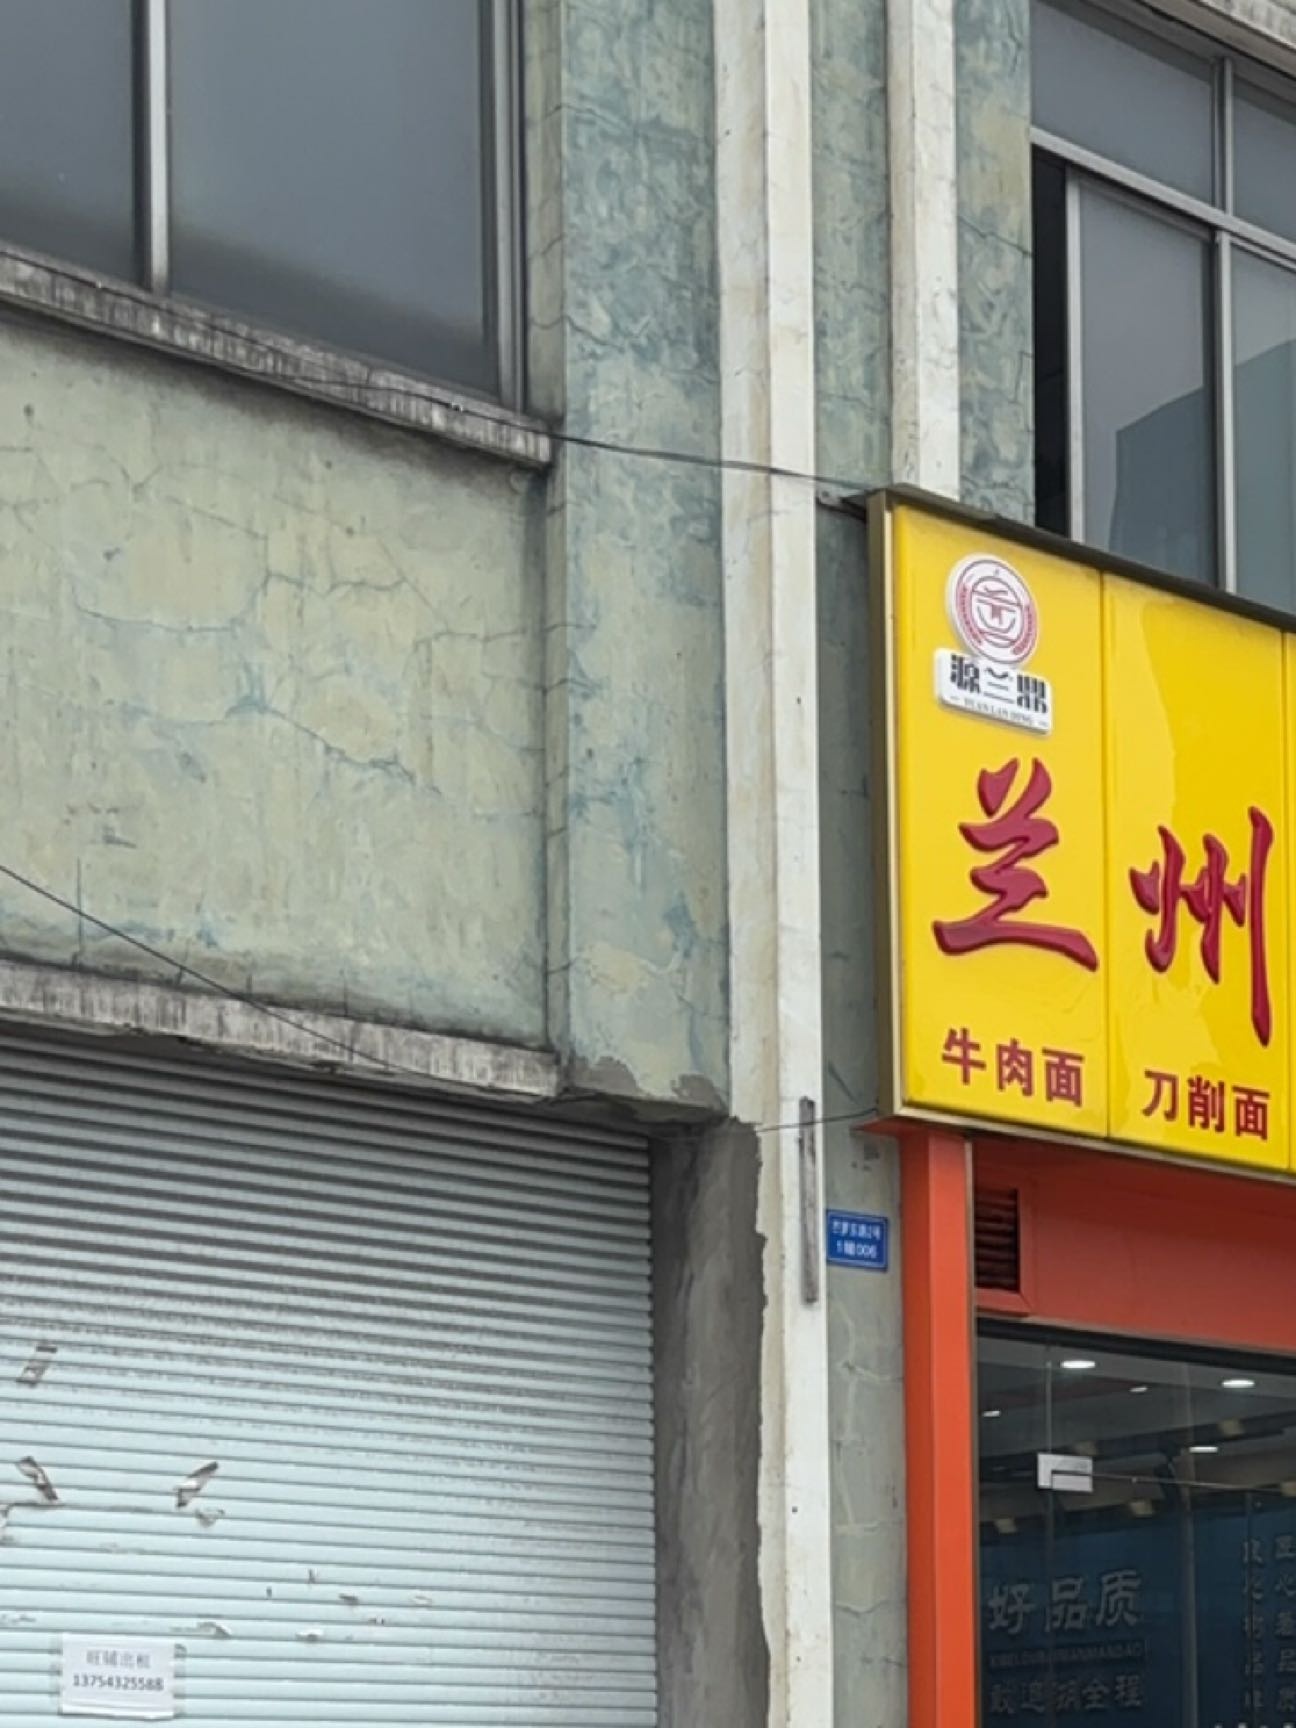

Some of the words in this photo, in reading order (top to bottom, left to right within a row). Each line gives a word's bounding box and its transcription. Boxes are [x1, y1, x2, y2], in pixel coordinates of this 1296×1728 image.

[941, 1027, 1085, 1108] 牛肉面
[1142, 1068, 1270, 1141] 刀削面
